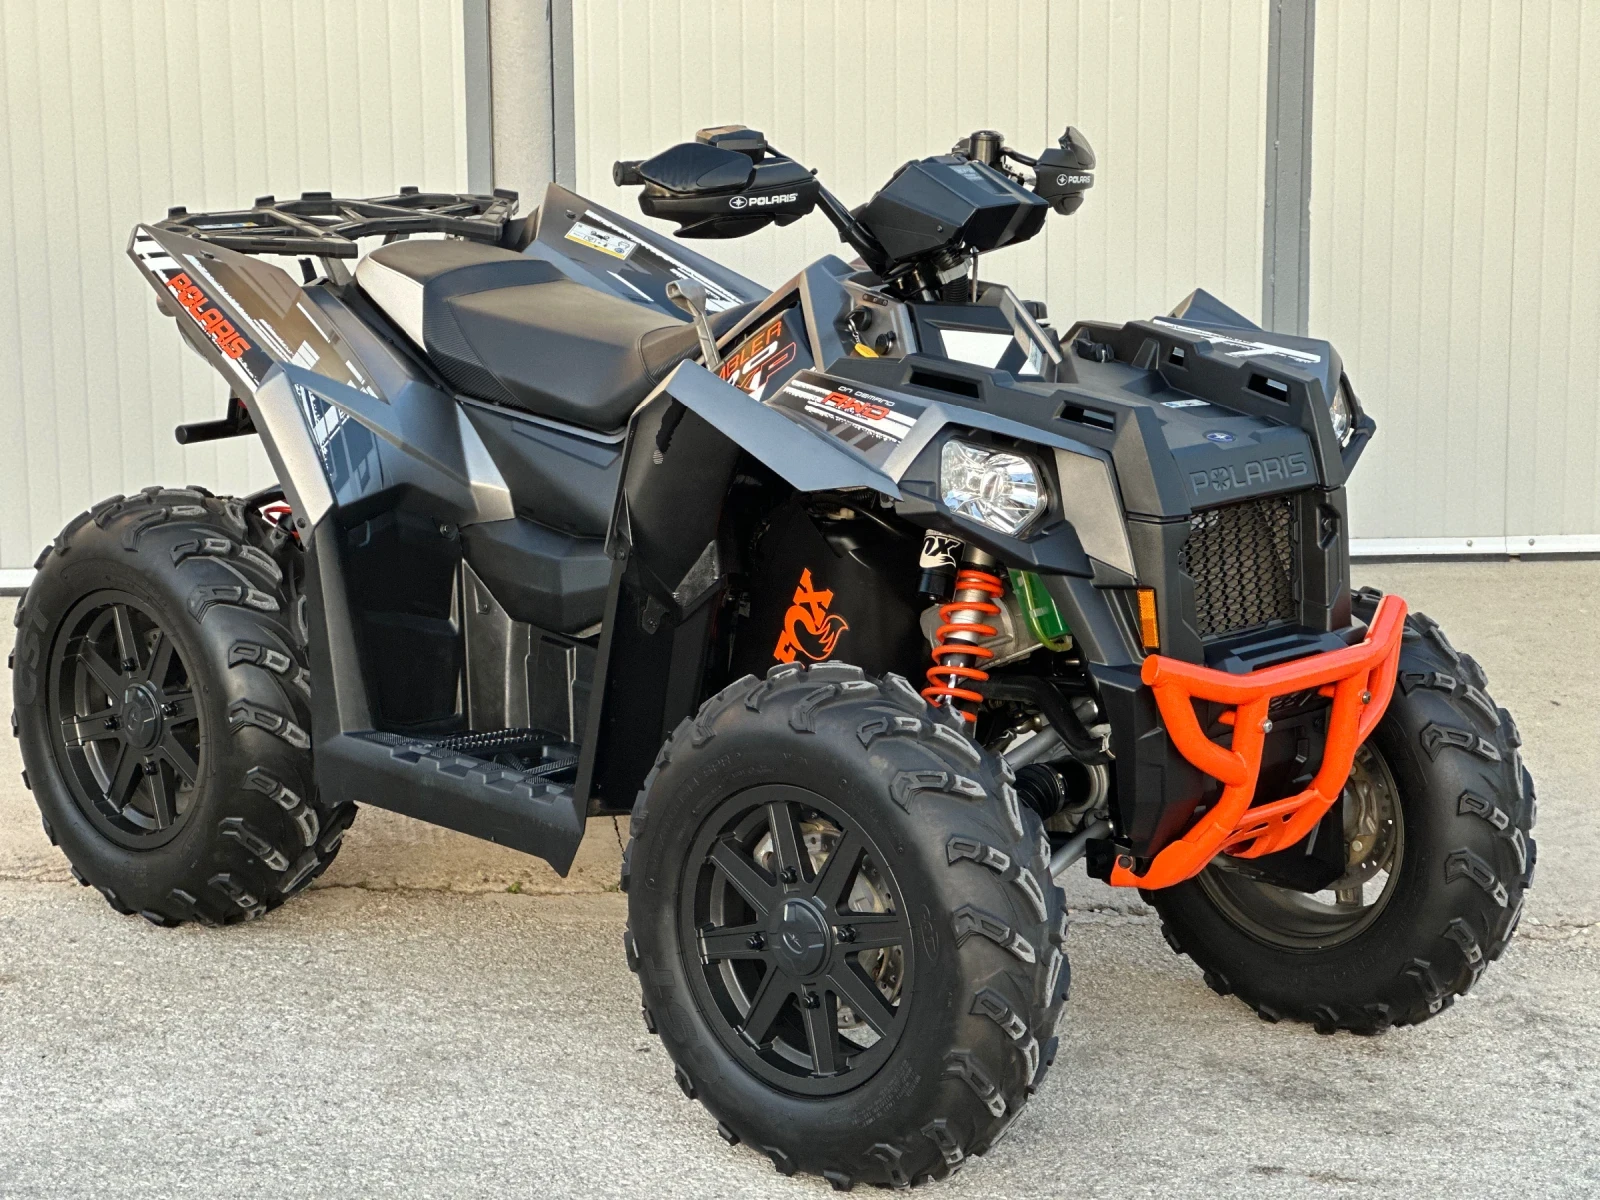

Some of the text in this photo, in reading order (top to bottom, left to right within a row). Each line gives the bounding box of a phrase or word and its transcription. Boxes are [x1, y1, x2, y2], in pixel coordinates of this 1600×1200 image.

[1068, 175, 1092, 185] POLARIS
[748, 193, 798, 207] POLARIS
[167, 272, 251, 360] POLARIS
[821, 391, 892, 421] AWD
[1189, 451, 1308, 497] POLARIS
[921, 535, 962, 563] OX
[773, 567, 849, 670] FOX
[17, 593, 50, 706] CST
